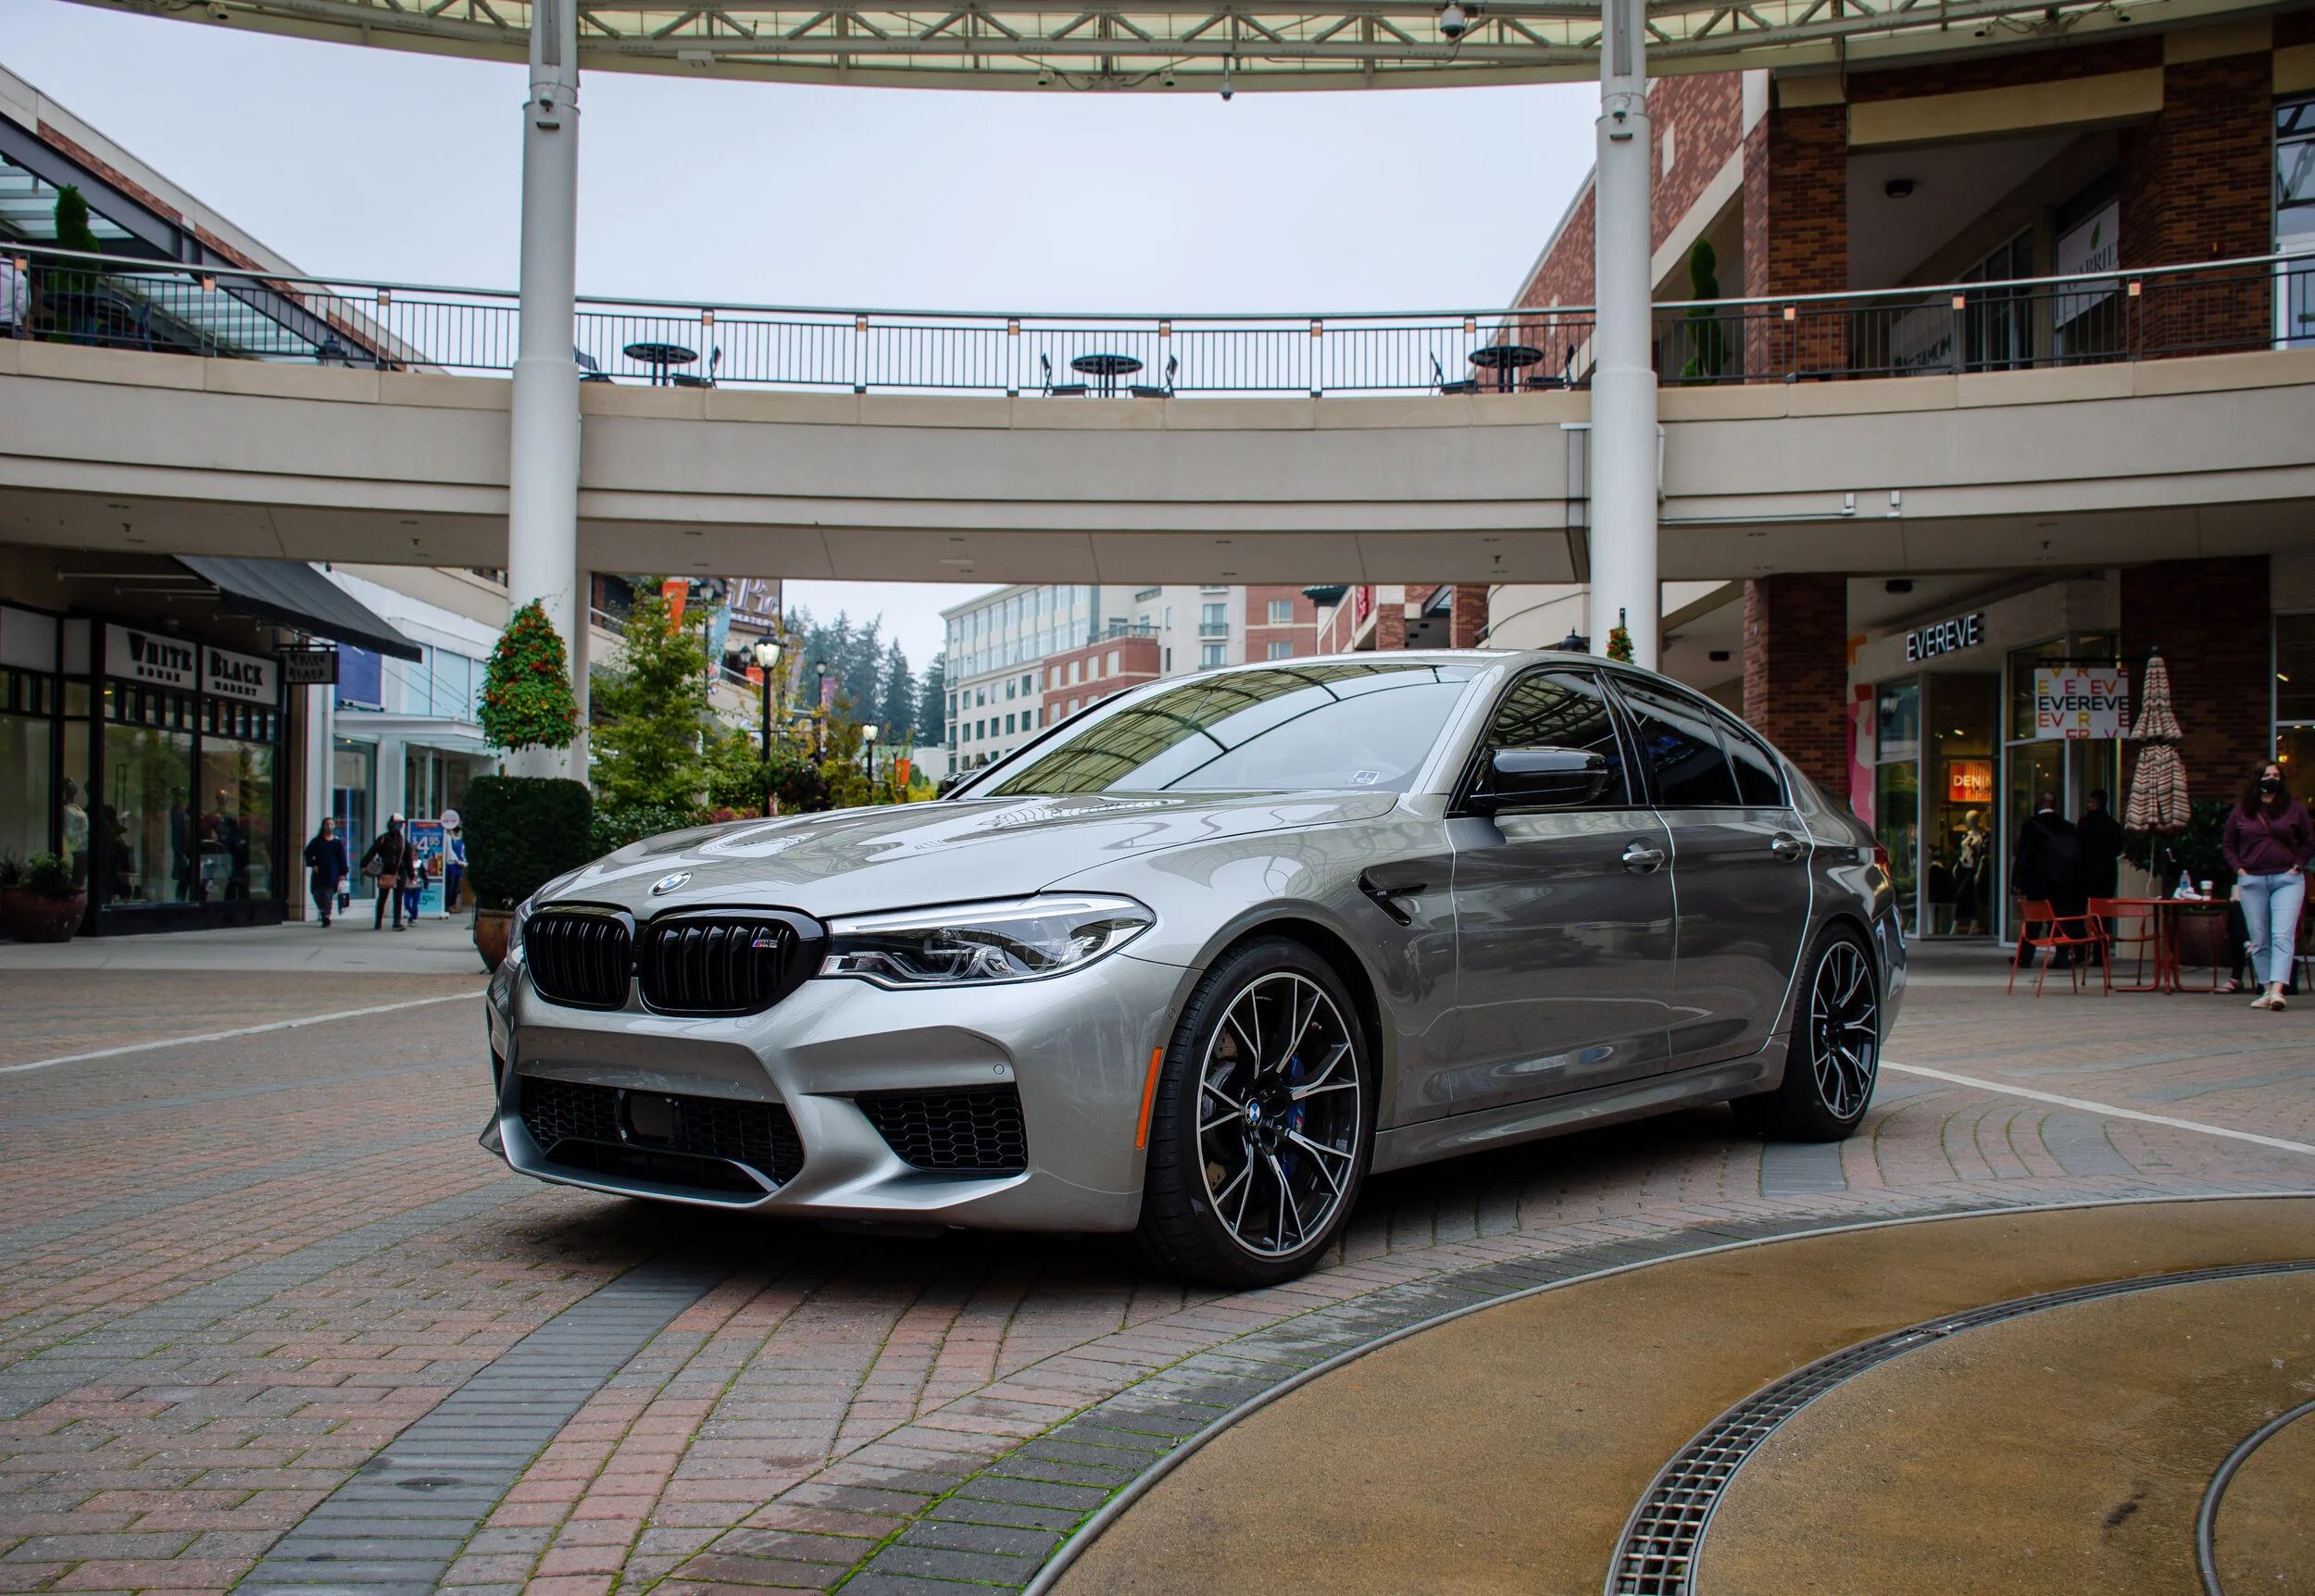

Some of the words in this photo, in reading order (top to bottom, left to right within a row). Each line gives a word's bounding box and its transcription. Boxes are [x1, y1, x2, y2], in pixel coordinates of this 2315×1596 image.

[127, 630, 192, 671] WHITE
[1906, 613, 1979, 662] EVEREVE
[209, 649, 264, 687] BLACK
[2038, 695, 2131, 711] EVEREVE
